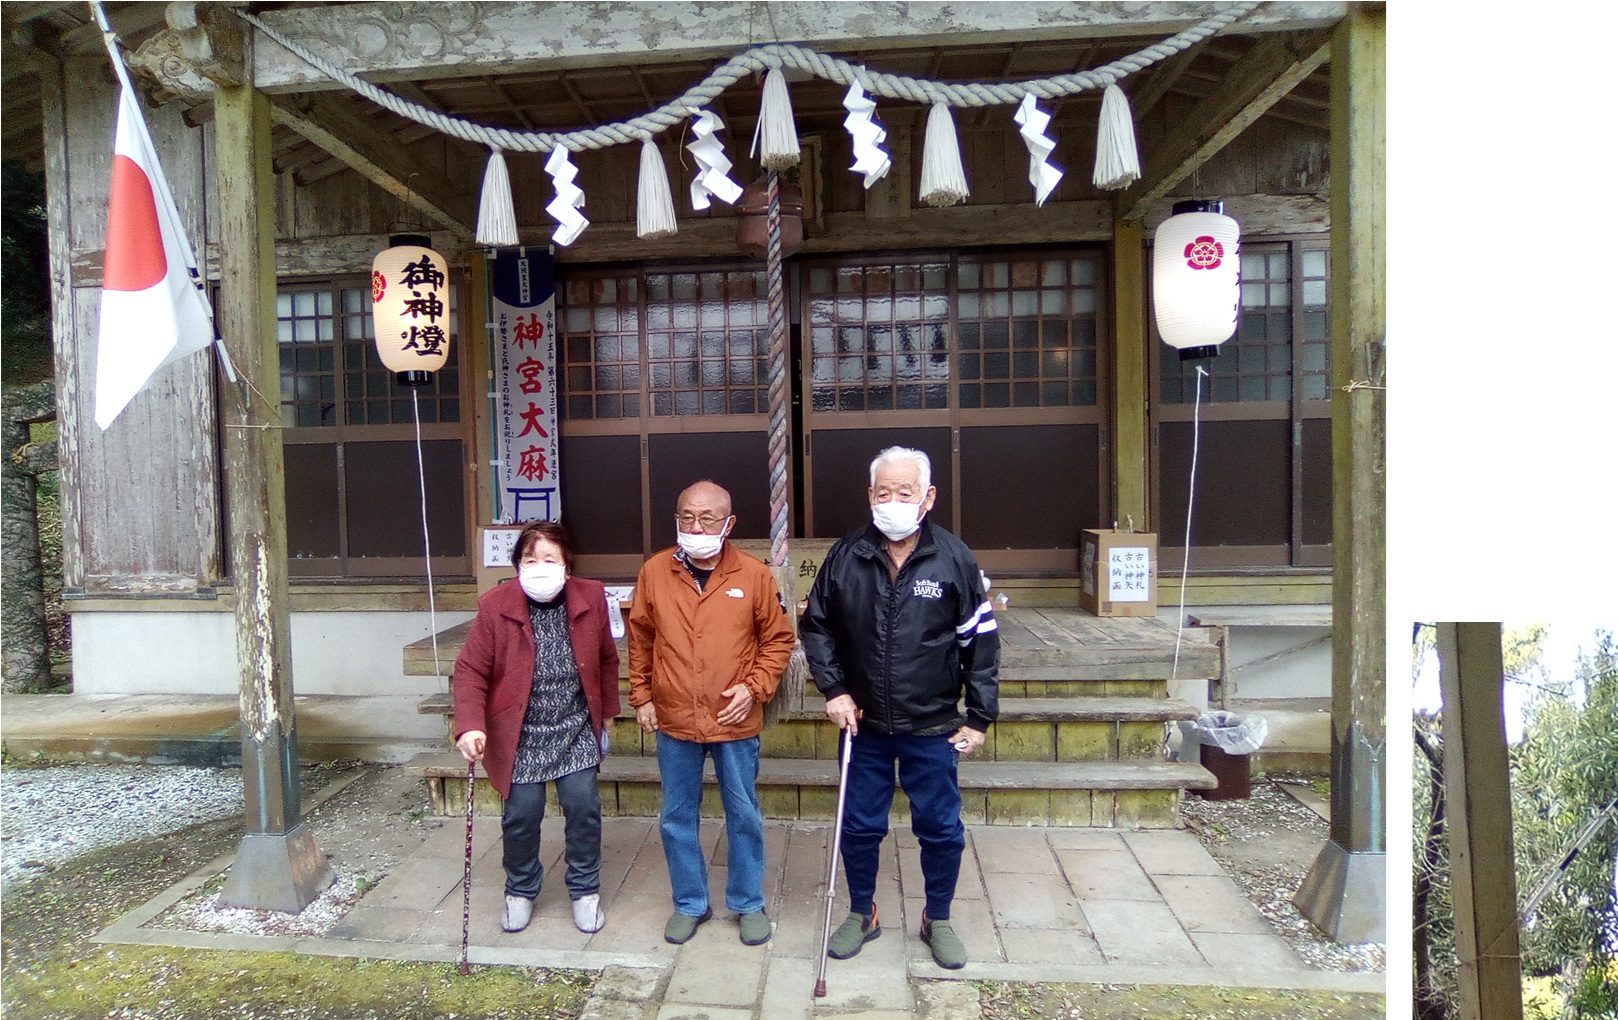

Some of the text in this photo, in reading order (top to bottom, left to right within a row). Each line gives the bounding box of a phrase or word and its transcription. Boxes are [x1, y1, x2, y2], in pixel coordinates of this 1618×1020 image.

[398, 253, 447, 357] 御神燈
[511, 312, 550, 483] 神宮大麻
[913, 586, 943, 598] HAWKS
